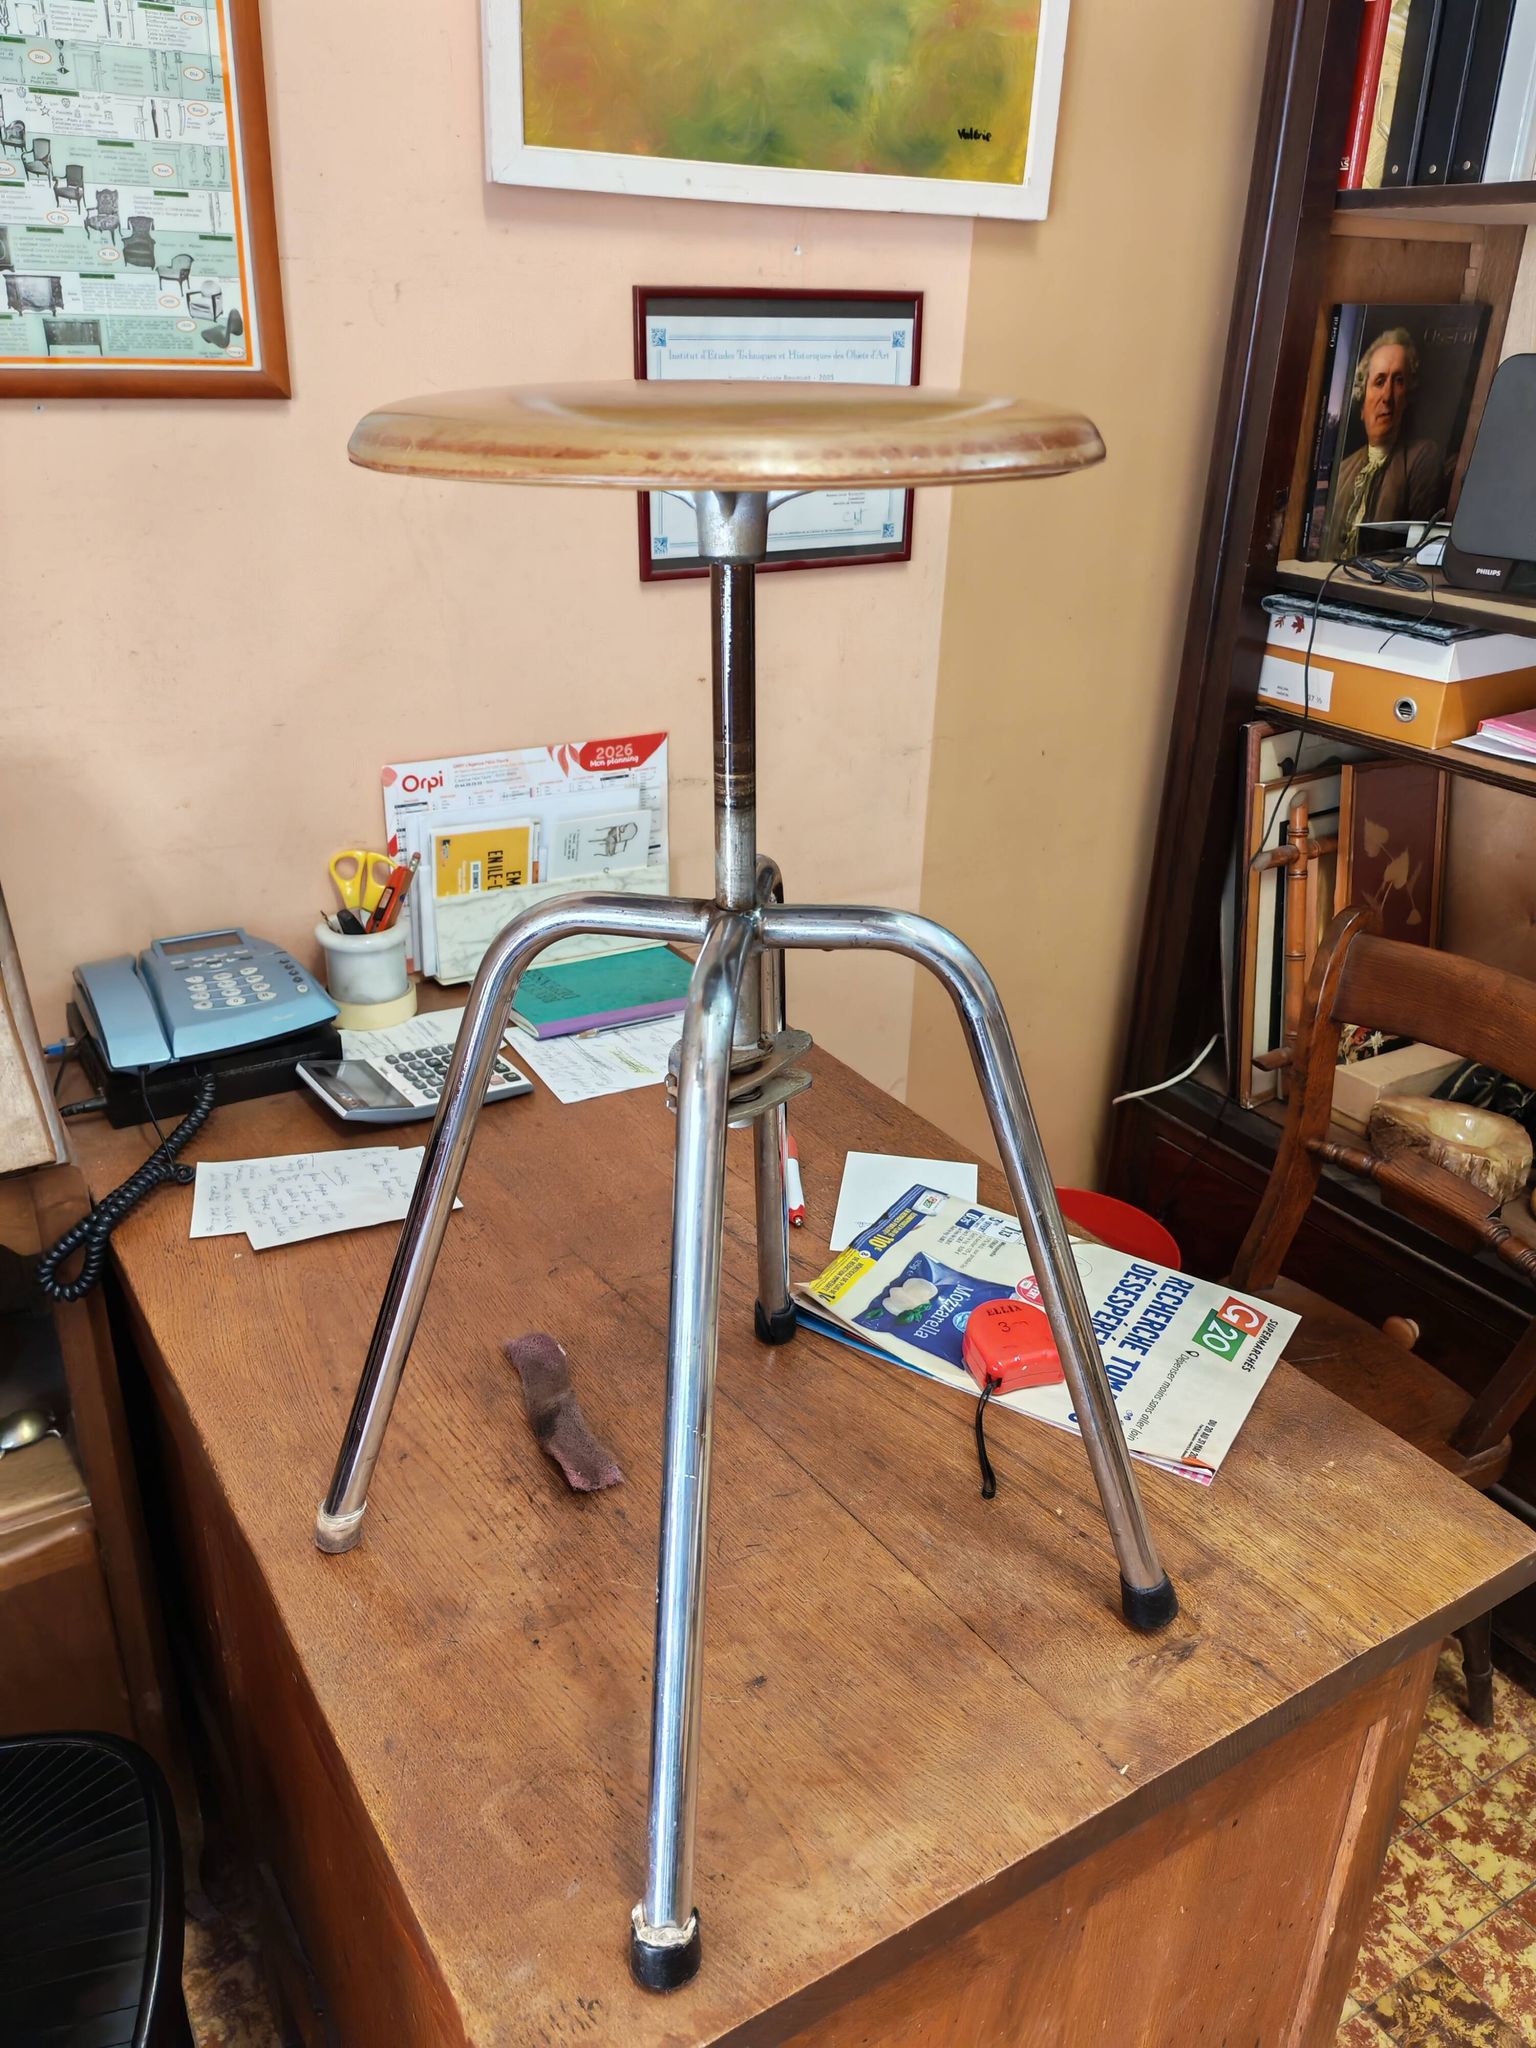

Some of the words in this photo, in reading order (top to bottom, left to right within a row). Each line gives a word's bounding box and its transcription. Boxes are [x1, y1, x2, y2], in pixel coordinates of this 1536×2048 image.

[669, 349, 698, 360] Institut
[1475, 567, 1501, 577] PHILIPS
[589, 758, 609, 768] Mon
[610, 754, 639, 767] planning
[596, 744, 633, 760] 2026
[402, 770, 444, 793] Orpi
[487, 850, 503, 864] EN
[913, 1282, 974, 1339] Mozzarella
[1092, 1263, 1158, 1346] DÉSESPÉRÉ
[1118, 1275, 1195, 1356] RECHERCHE
[1241, 1318, 1279, 1373] SUPERMARCHÉS
[1167, 1353, 1190, 1383] Dépenser
[1154, 1380, 1173, 1401] moins
[1144, 1399, 1160, 1415] sans
[1135, 1412, 1151, 1430] aller
[1127, 1426, 1142, 1442] loin
